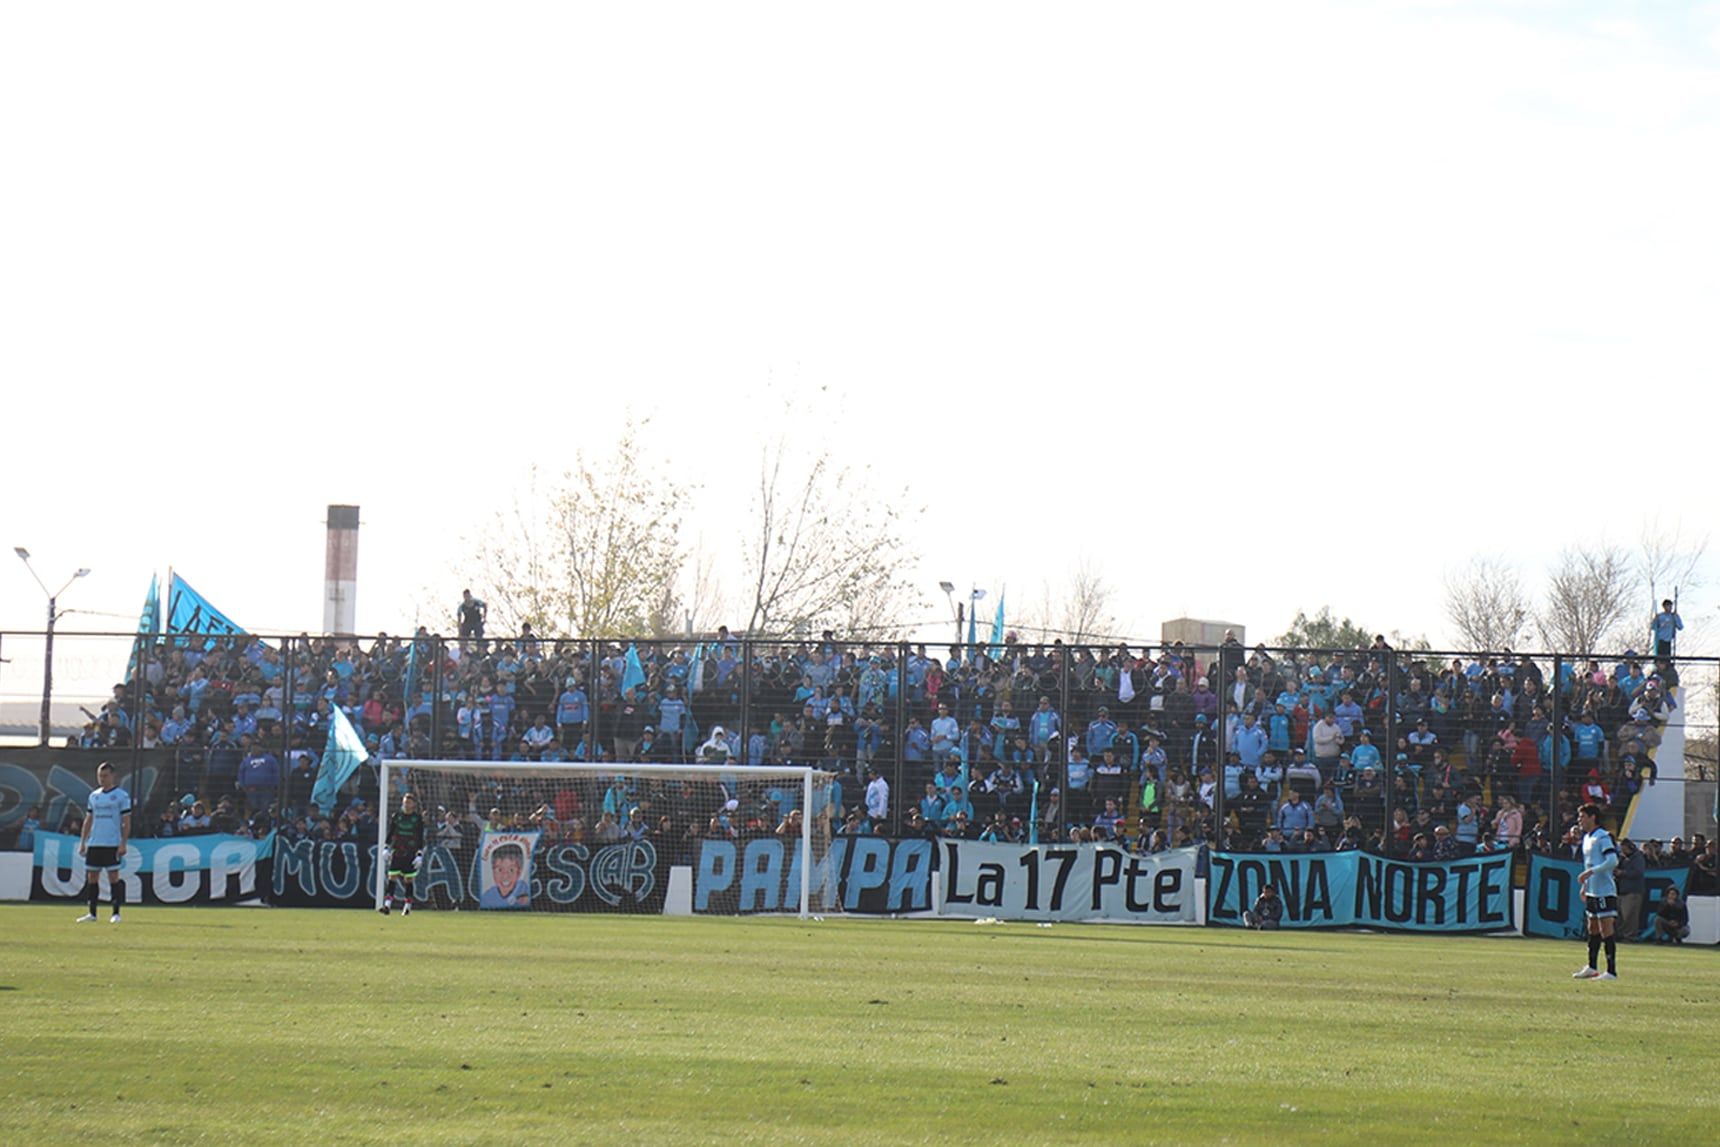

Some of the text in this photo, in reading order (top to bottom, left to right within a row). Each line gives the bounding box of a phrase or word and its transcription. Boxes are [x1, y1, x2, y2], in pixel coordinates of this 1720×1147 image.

[695, 838, 932, 910] PAMPA
[946, 843, 1182, 913] La 17 Pte
[1211, 857, 1334, 921] ZONA
[1354, 856, 1507, 925] NORTE
